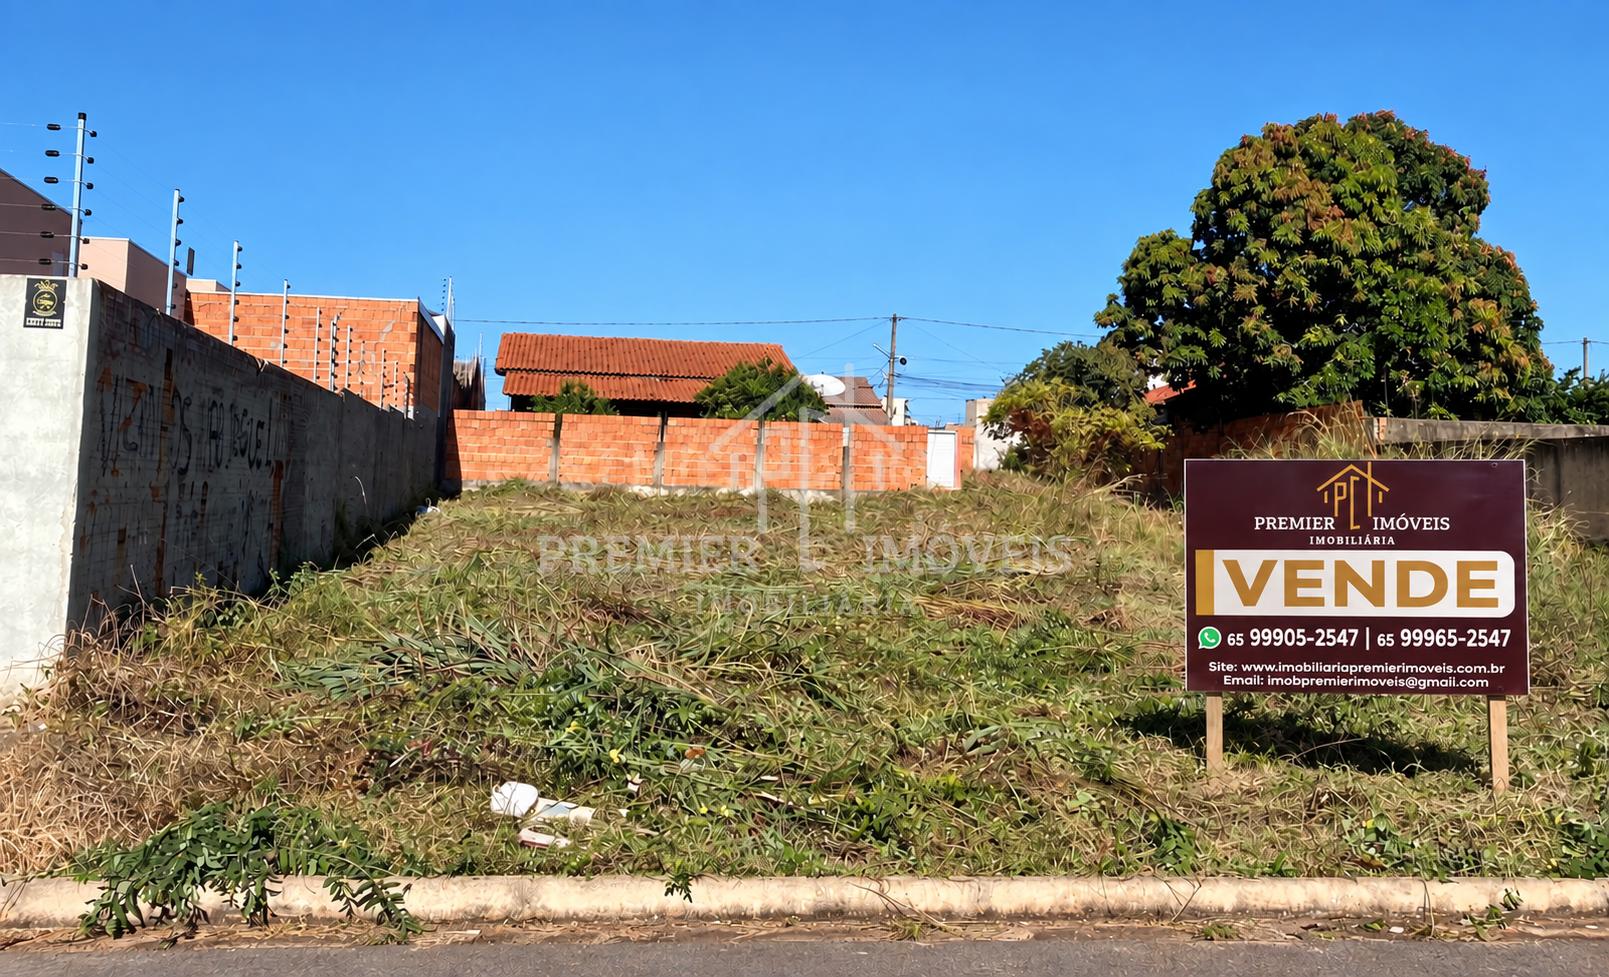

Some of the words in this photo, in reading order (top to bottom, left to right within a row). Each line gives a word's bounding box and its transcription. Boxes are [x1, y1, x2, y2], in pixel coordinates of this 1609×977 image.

[1254, 516, 1335, 531] PREMIER
[1372, 513, 1451, 531] IMÓVEIS
[1309, 534, 1396, 545] IMOBILIÁRIA
[1222, 559, 1499, 608] VENDE
[1227, 633, 1245, 647] 65
[1249, 628, 1359, 647] 99905-2547
[1376, 633, 1395, 648] 65
[1400, 628, 1511, 648] 99965-2547
[1208, 661, 1238, 672] Site:
[1241, 661, 1506, 675] www.imobiliariapremierimoveis.com.br
[1223, 674, 1264, 686] Email:
[1267, 674, 1489, 689] imobpremierimoveis@gmail.com
